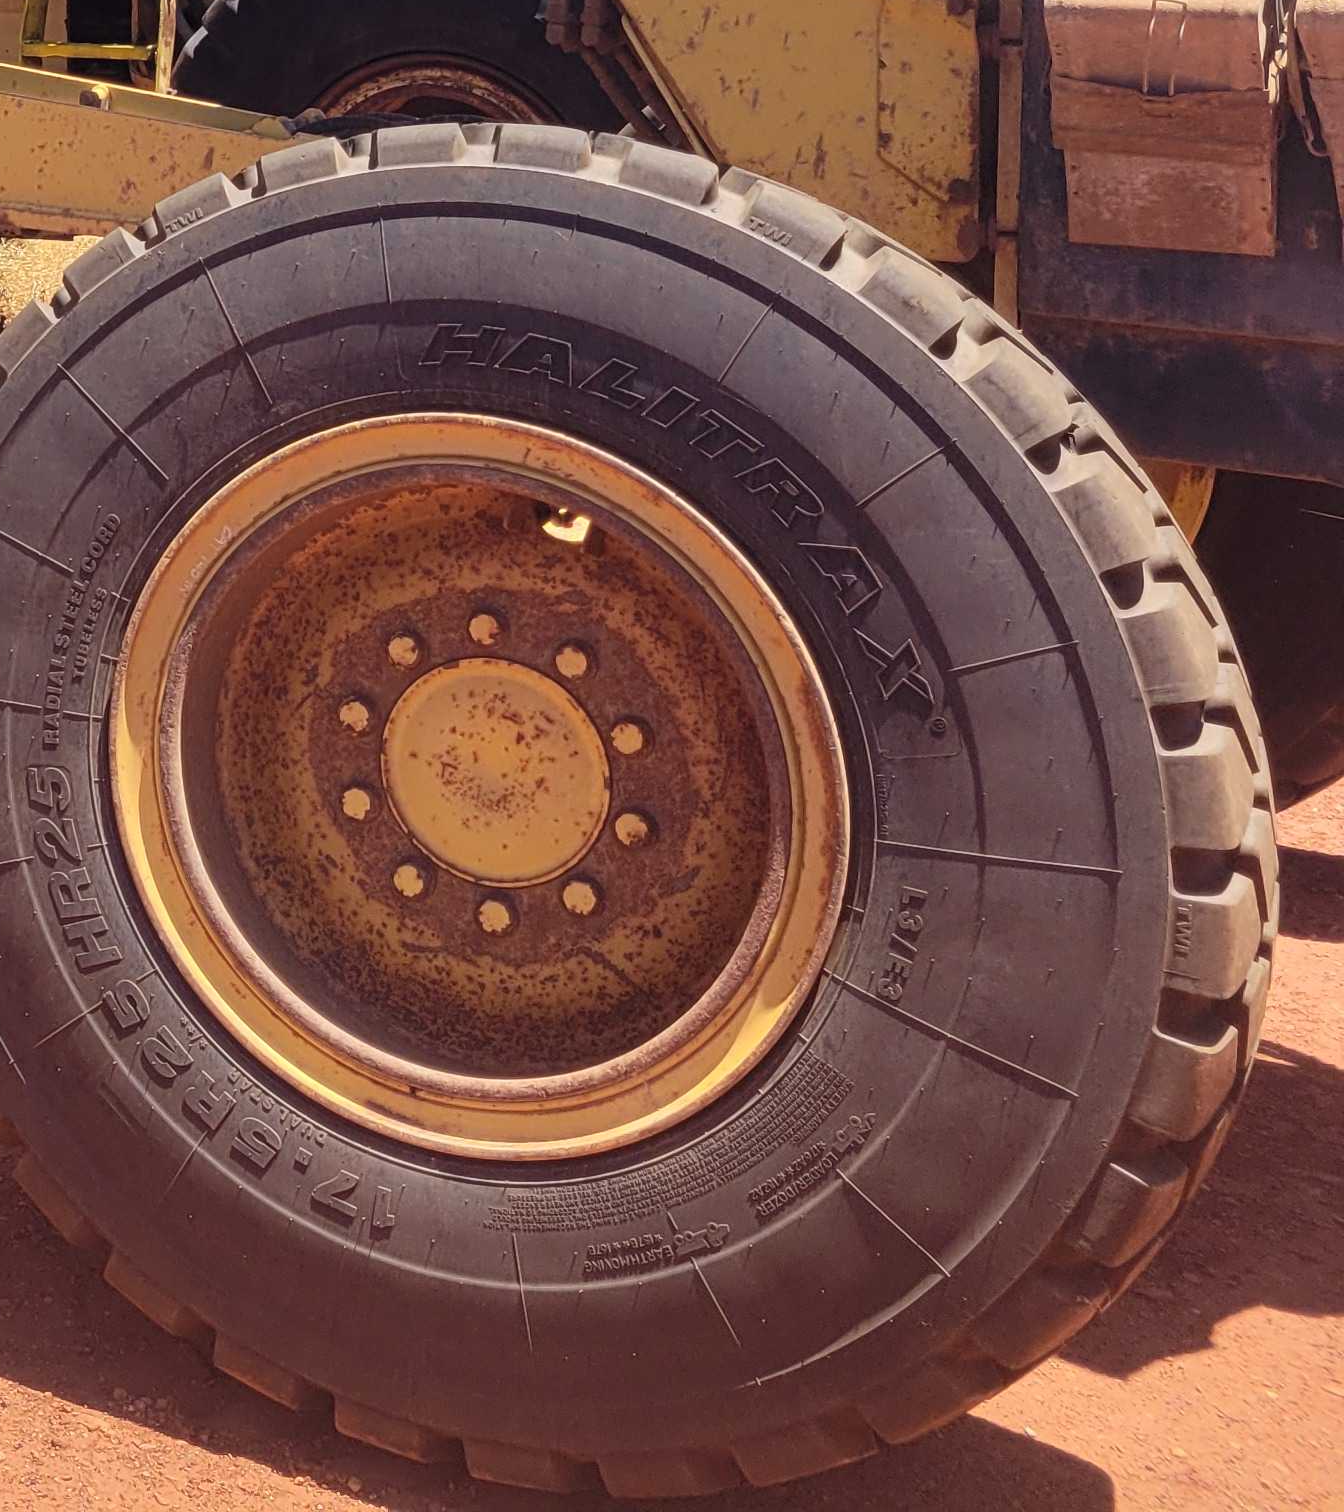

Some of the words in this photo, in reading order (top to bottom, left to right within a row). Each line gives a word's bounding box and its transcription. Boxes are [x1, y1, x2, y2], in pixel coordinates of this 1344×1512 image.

[165, 207, 205, 233] TWI
[80, 512, 121, 574] CORD
[418, 323, 936, 705] HALITRAX
[53, 578, 90, 651] STEEL
[72, 587, 108, 684] TUBELESS
[42, 655, 65, 750] RADIAL
[26, 766, 123, 973] HR25
[102, 979, 396, 1230] 17.5R25
[757, 1151, 839, 1216] LOADER/DOZER
